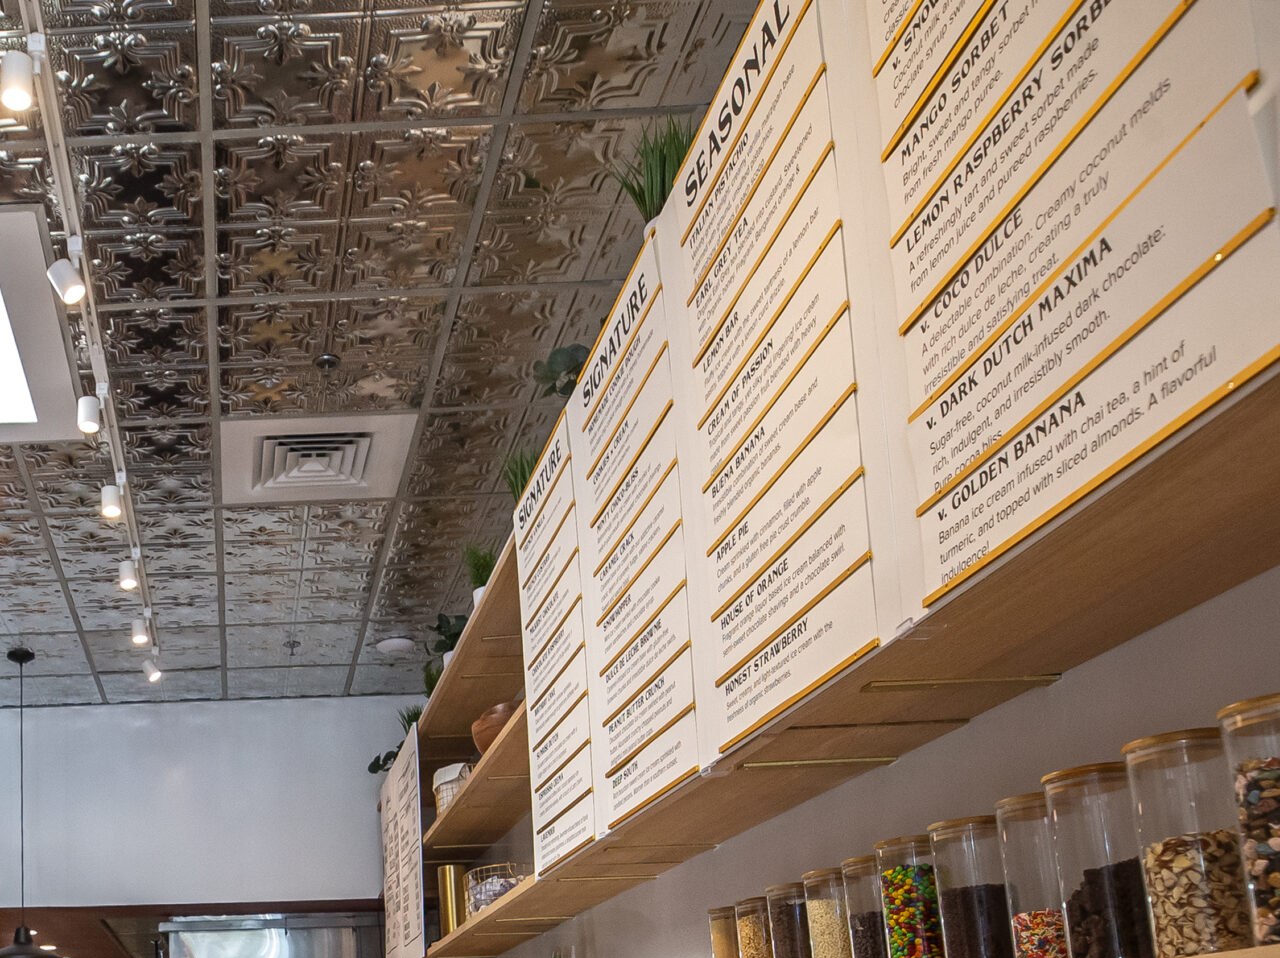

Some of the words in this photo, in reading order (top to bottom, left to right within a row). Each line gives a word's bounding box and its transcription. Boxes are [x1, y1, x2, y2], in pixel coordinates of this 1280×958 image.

[685, 0, 790, 207] SEASONAL
[892, 38, 923, 90] Coconut
[924, 11, 940, 42] milk
[901, 92, 947, 166] MANGO
[951, 0, 1009, 93] SORBET
[902, 149, 927, 186] Bright,
[928, 112, 952, 152] sweet
[953, 85, 970, 116] and
[970, 51, 996, 91] tangy
[998, 0, 1030, 54] sorbet
[925, 23, 947, 60] syrup
[689, 198, 714, 249] ITALIAN
[714, 132, 748, 202] PISTACHIO
[904, 177, 921, 205] from
[922, 149, 942, 180] fresh
[943, 108, 972, 152] mango
[974, 69, 1004, 113] puree.
[906, 189, 949, 253] LEMON
[953, 68, 1042, 195] RASPBERRY
[909, 260, 915, 275] A
[916, 203, 962, 265] refreshingly
[963, 182, 979, 207] tart
[980, 157, 998, 187] and
[999, 121, 1029, 164] sweet
[1030, 77, 1065, 126] sorbet
[1066, 37, 1099, 82] made
[910, 267, 928, 293] from
[929, 236, 954, 271] lemon
[955, 210, 976, 245] juice
[978, 184, 995, 214] and
[997, 140, 1032, 194] pureed
[1034, 68, 1098, 147] raspberries.
[695, 278, 713, 308] EARL
[713, 241, 731, 278] GREY
[733, 216, 748, 244] TEA
[921, 342, 928, 357] A
[929, 296, 972, 348] delectable
[974, 228, 1033, 299] combination:
[1035, 179, 1076, 230] Creamy
[1078, 123, 1128, 183] coconut
[1129, 77, 1171, 128] melds
[922, 352, 939, 376] with
[941, 335, 956, 357] rich
[958, 308, 982, 339] dulce
[983, 293, 996, 312] de
[1028, 212, 1071, 264] creating
[1082, 170, 1109, 206] truly
[582, 272, 647, 408] SIGNATURE
[702, 333, 724, 373] LEMON
[725, 311, 738, 338] BAR
[924, 348, 966, 395] irresistible
[967, 324, 985, 352] and
[986, 281, 1030, 335] satisfying
[929, 410, 975, 456] Sugar-free,
[976, 371, 1012, 413] coconut
[1013, 310, 1073, 378] milk-infused
[1074, 287, 1100, 318] dark
[1102, 225, 1165, 292] chocolate:
[933, 264, 970, 318] COCO
[939, 370, 978, 418] DARK
[983, 313, 1034, 377] DUTCH
[1038, 237, 1112, 321] MAXIMA
[707, 399, 730, 436] CREAM
[731, 383, 740, 403] OF
[741, 338, 773, 389] PASSION
[938, 514, 970, 545] Banana
[971, 502, 984, 520] ice
[986, 479, 1015, 508] cream
[1017, 445, 1053, 484] infused
[1055, 428, 1078, 454] with
[1080, 405, 1104, 434] chai
[1143, 356, 1168, 386] hint
[1170, 339, 1184, 363] of
[950, 415, 993, 459] indulgent,
[994, 394, 1012, 420] and
[1012, 349, 1063, 402] irresistibly
[1065, 310, 1110, 355] smooth.
[951, 451, 1009, 510] GOLDEN
[1013, 391, 1085, 461] BANANA
[518, 438, 561, 530] SIGNATURE
[711, 465, 734, 498] BUENA
[735, 426, 765, 470] BANANA
[939, 532, 976, 565] turmeric,
[977, 514, 994, 537] and
[996, 487, 1030, 523] topped
[1032, 472, 1054, 495] with
[1056, 443, 1088, 479] sliced
[1090, 406, 1144, 453] almonds.
[1147, 392, 1158, 410] A
[1160, 345, 1216, 399] flavorful
[716, 533, 736, 563] APPLE
[738, 520, 749, 540] PIE
[720, 600, 744, 630] HOUSE
[744, 589, 754, 607] OF
[756, 557, 788, 596] ORANGE
[725, 664, 751, 696] HONEST
[753, 617, 808, 672] STRAWBERRY
